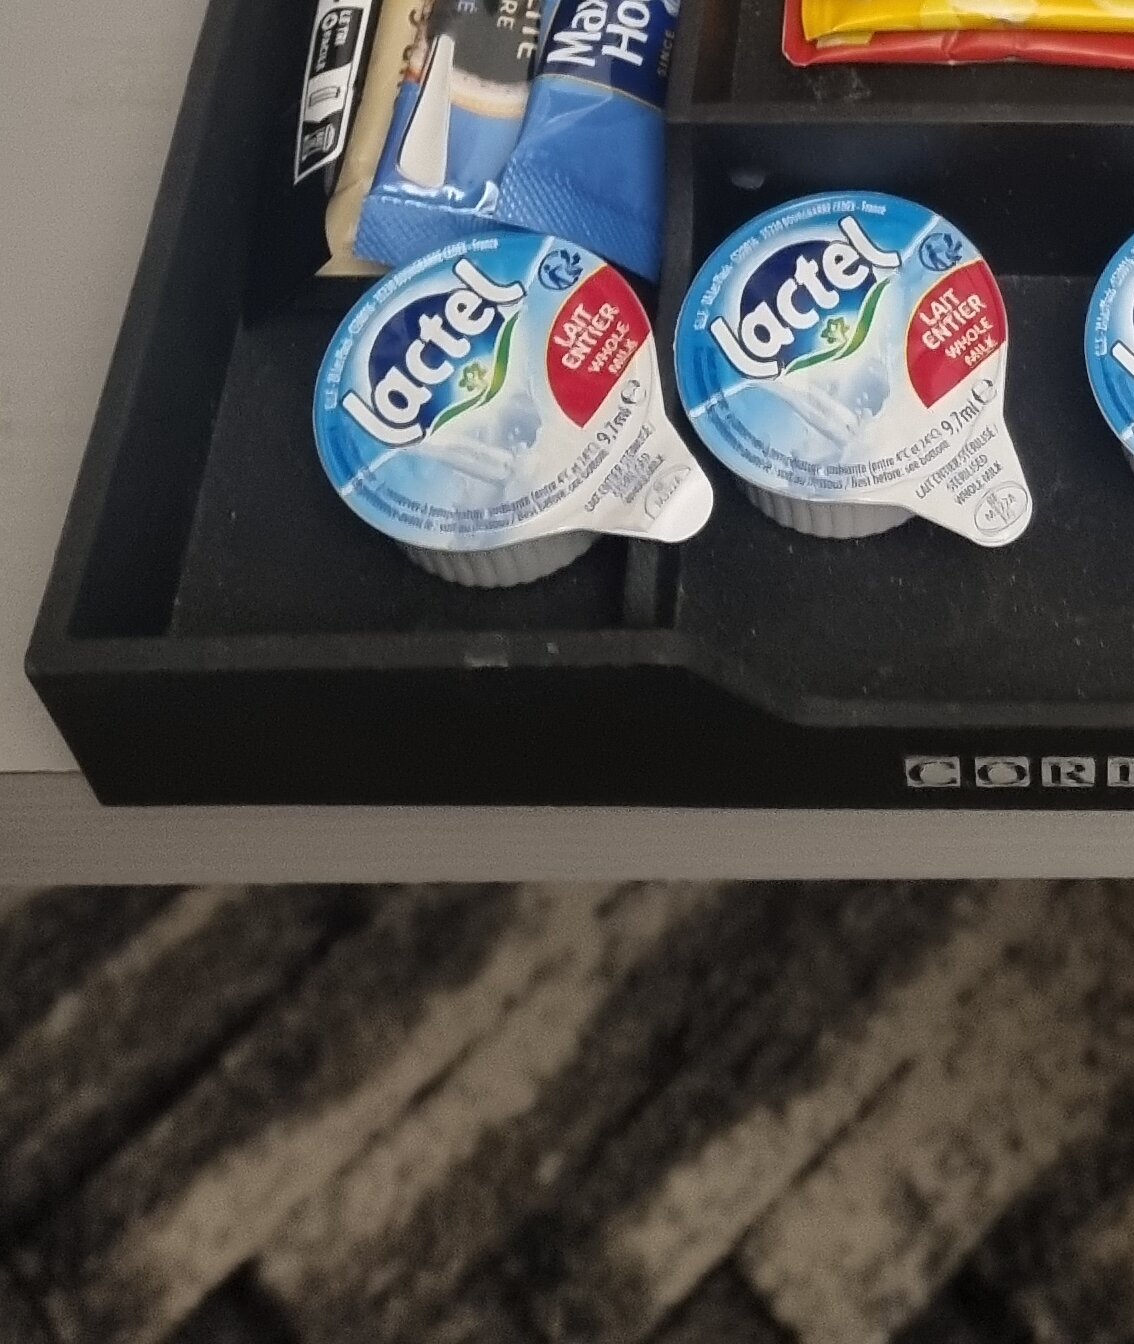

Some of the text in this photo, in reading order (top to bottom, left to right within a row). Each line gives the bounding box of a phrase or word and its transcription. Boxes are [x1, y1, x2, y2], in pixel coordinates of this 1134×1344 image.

[708, 214, 903, 382] lactel
[919, 287, 961, 326] LAIT
[922, 294, 987, 350] ENTIER
[554, 302, 594, 348] LAIT
[562, 302, 620, 370] ENTIER
[588, 320, 630, 373] WHOLE
[945, 316, 994, 359] WHOLE
[342, 256, 526, 449] lactel
[608, 338, 638, 374] MILK
[964, 333, 997, 367] MILK
